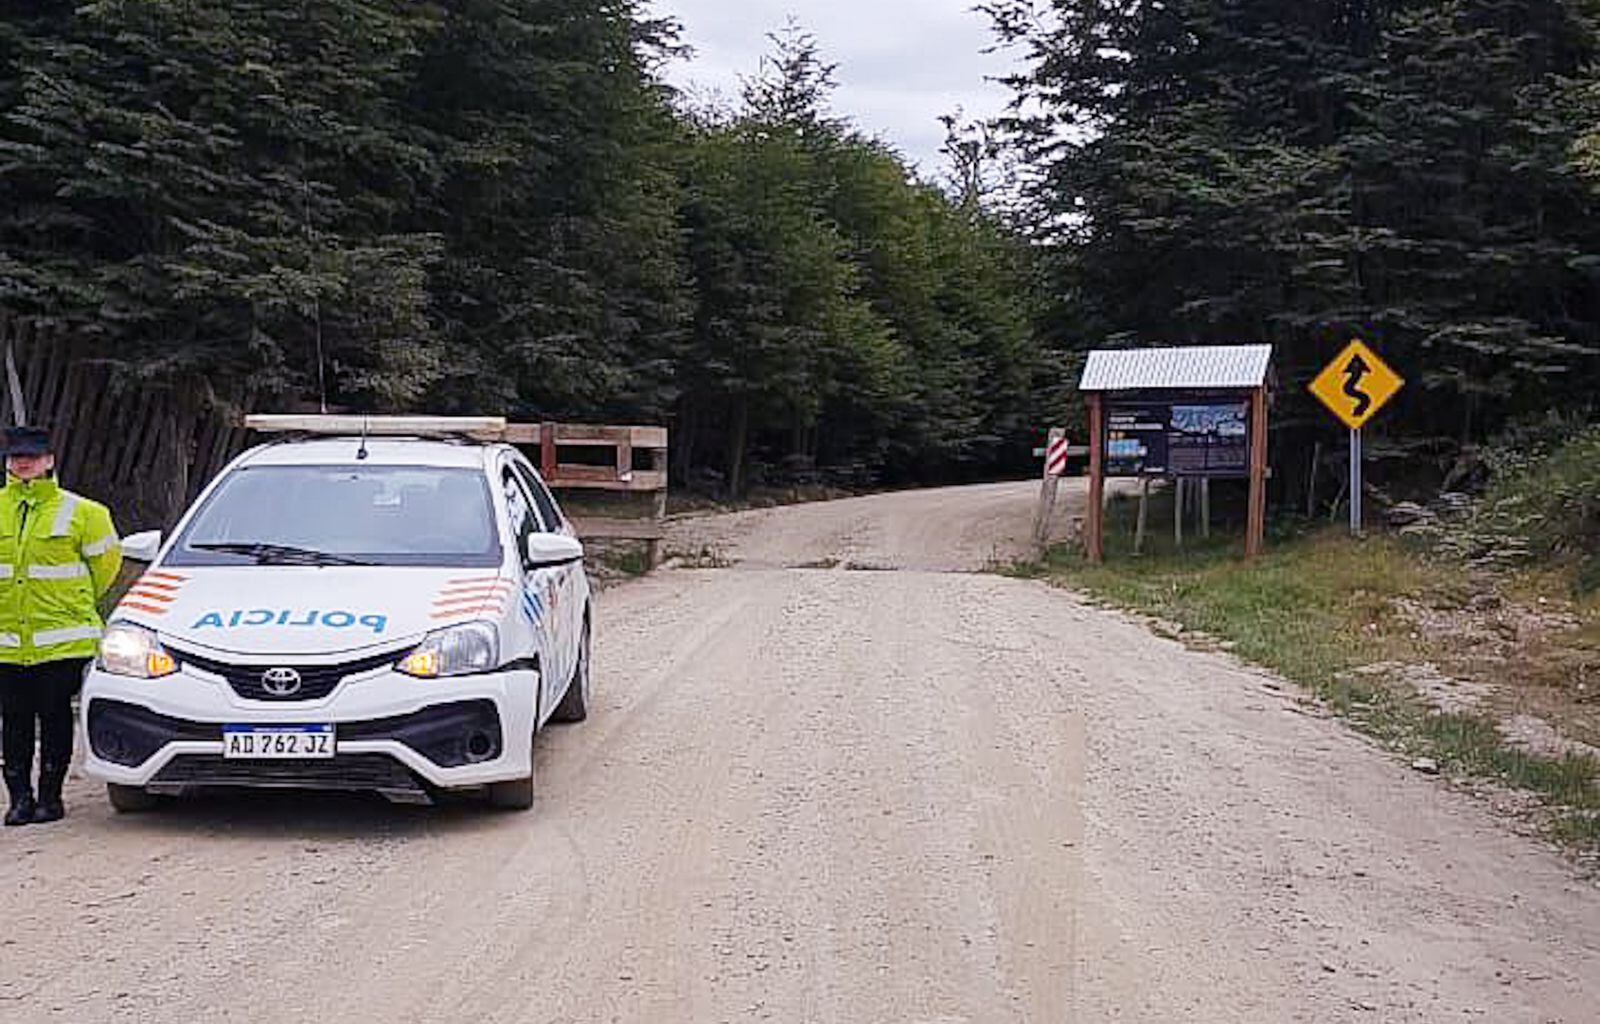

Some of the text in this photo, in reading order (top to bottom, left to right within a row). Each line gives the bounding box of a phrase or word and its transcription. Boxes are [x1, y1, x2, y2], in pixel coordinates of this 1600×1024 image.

[230, 735, 329, 753] AD 762 JZ
